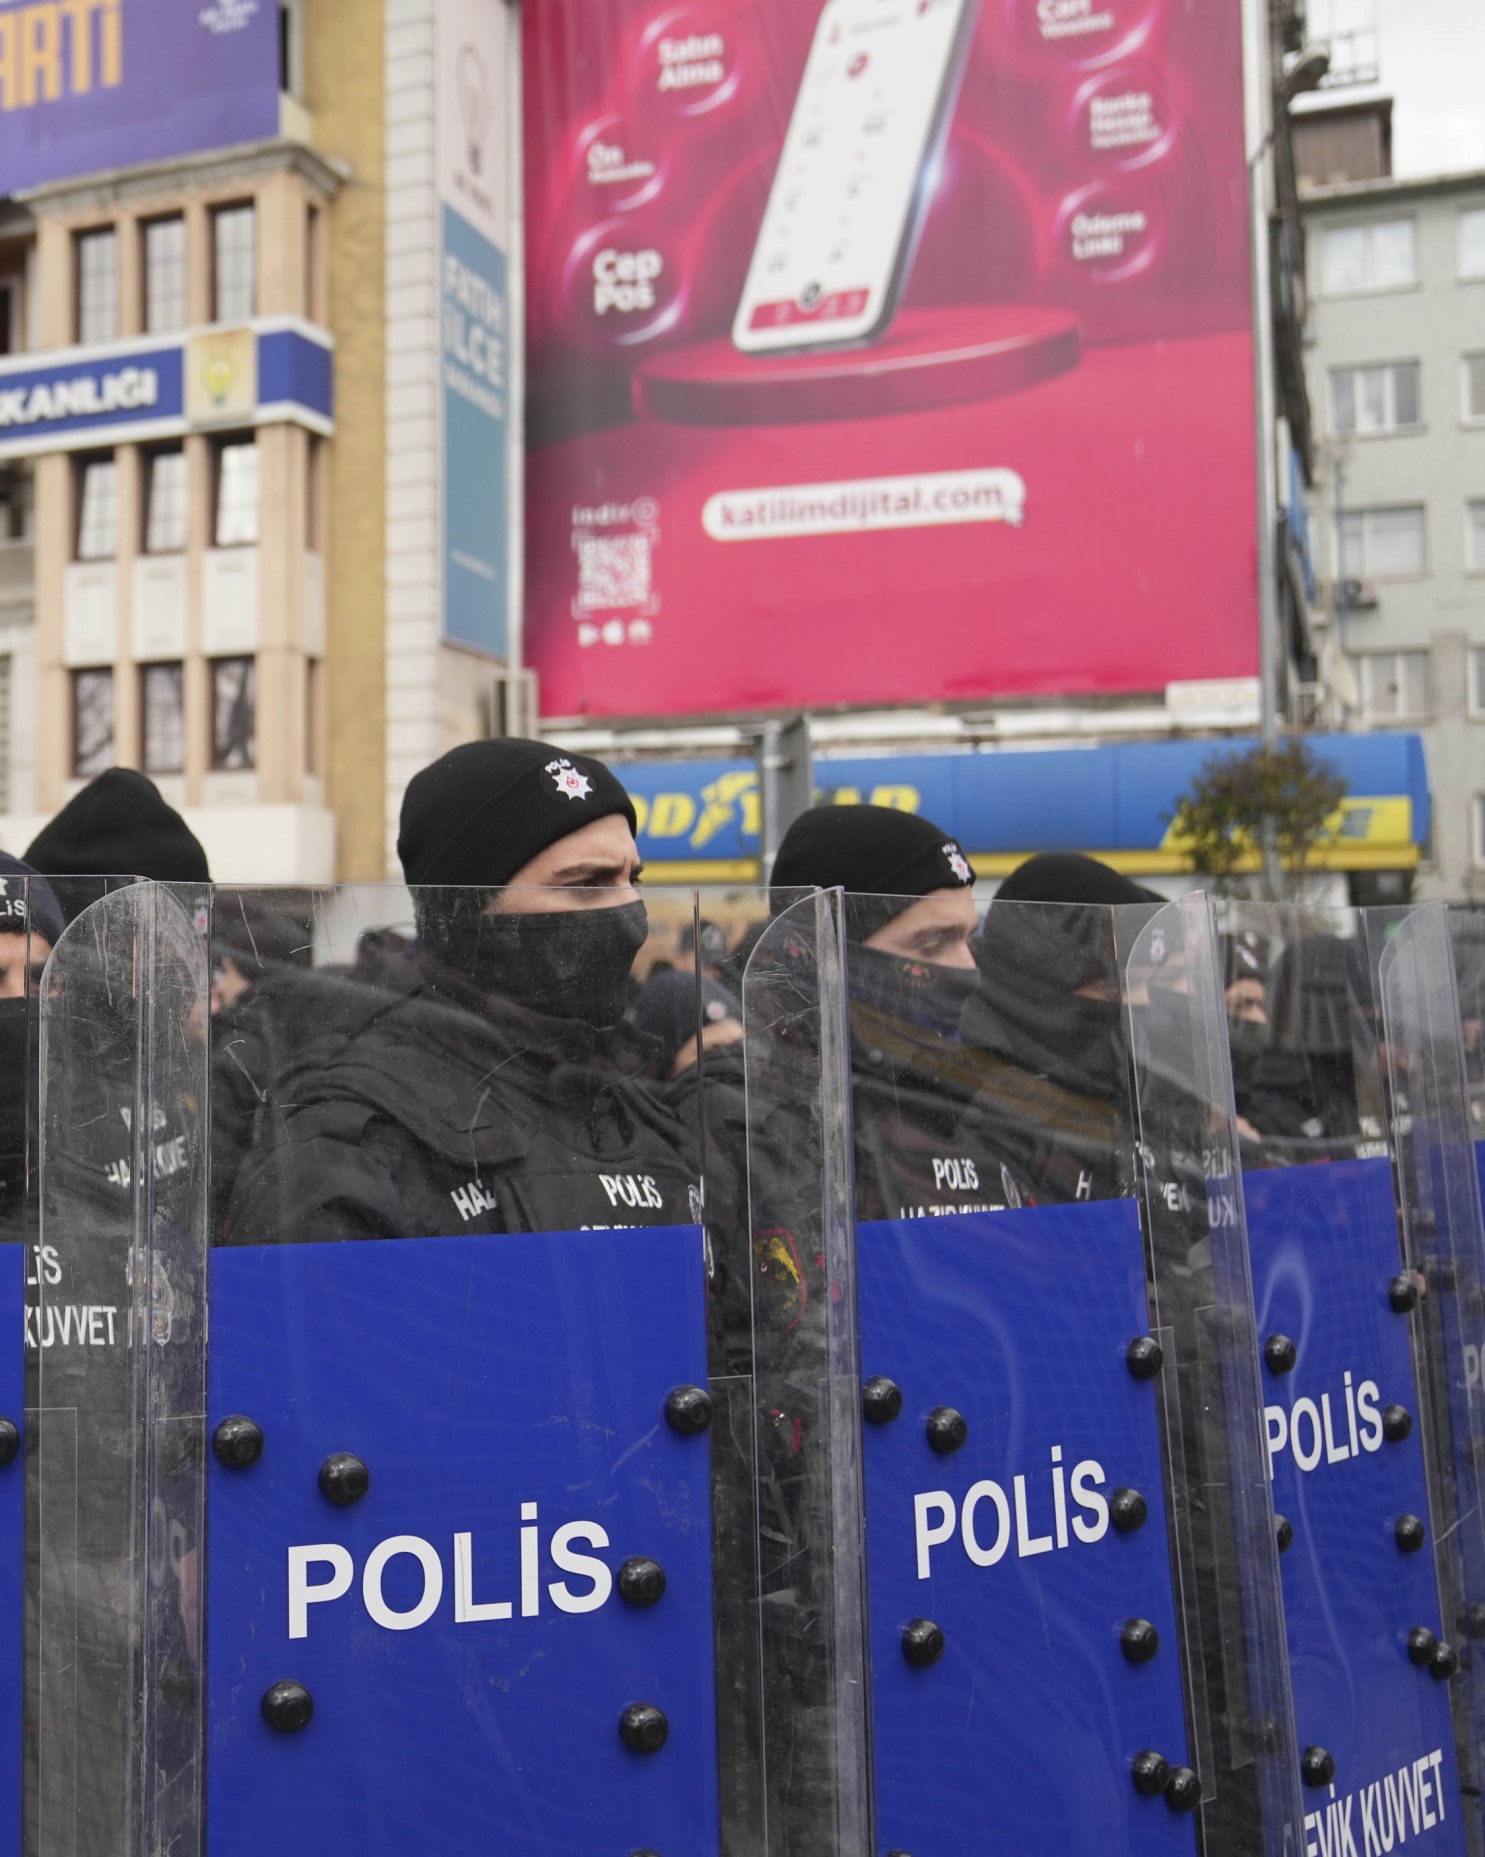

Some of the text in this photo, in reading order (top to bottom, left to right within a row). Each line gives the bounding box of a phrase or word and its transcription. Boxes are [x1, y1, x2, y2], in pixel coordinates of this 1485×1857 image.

[593, 249, 662, 284] Cep
[594, 280, 654, 314] Pos
[721, 483, 1002, 530] katilimdijital.com
[24, 1304, 117, 1348] KUVVET
[1262, 1371, 1384, 1481] POLİS
[914, 1445, 1109, 1579] POLİS
[288, 1502, 612, 1639] POLİS
[1359, 1748, 1446, 1857] KUVVET
